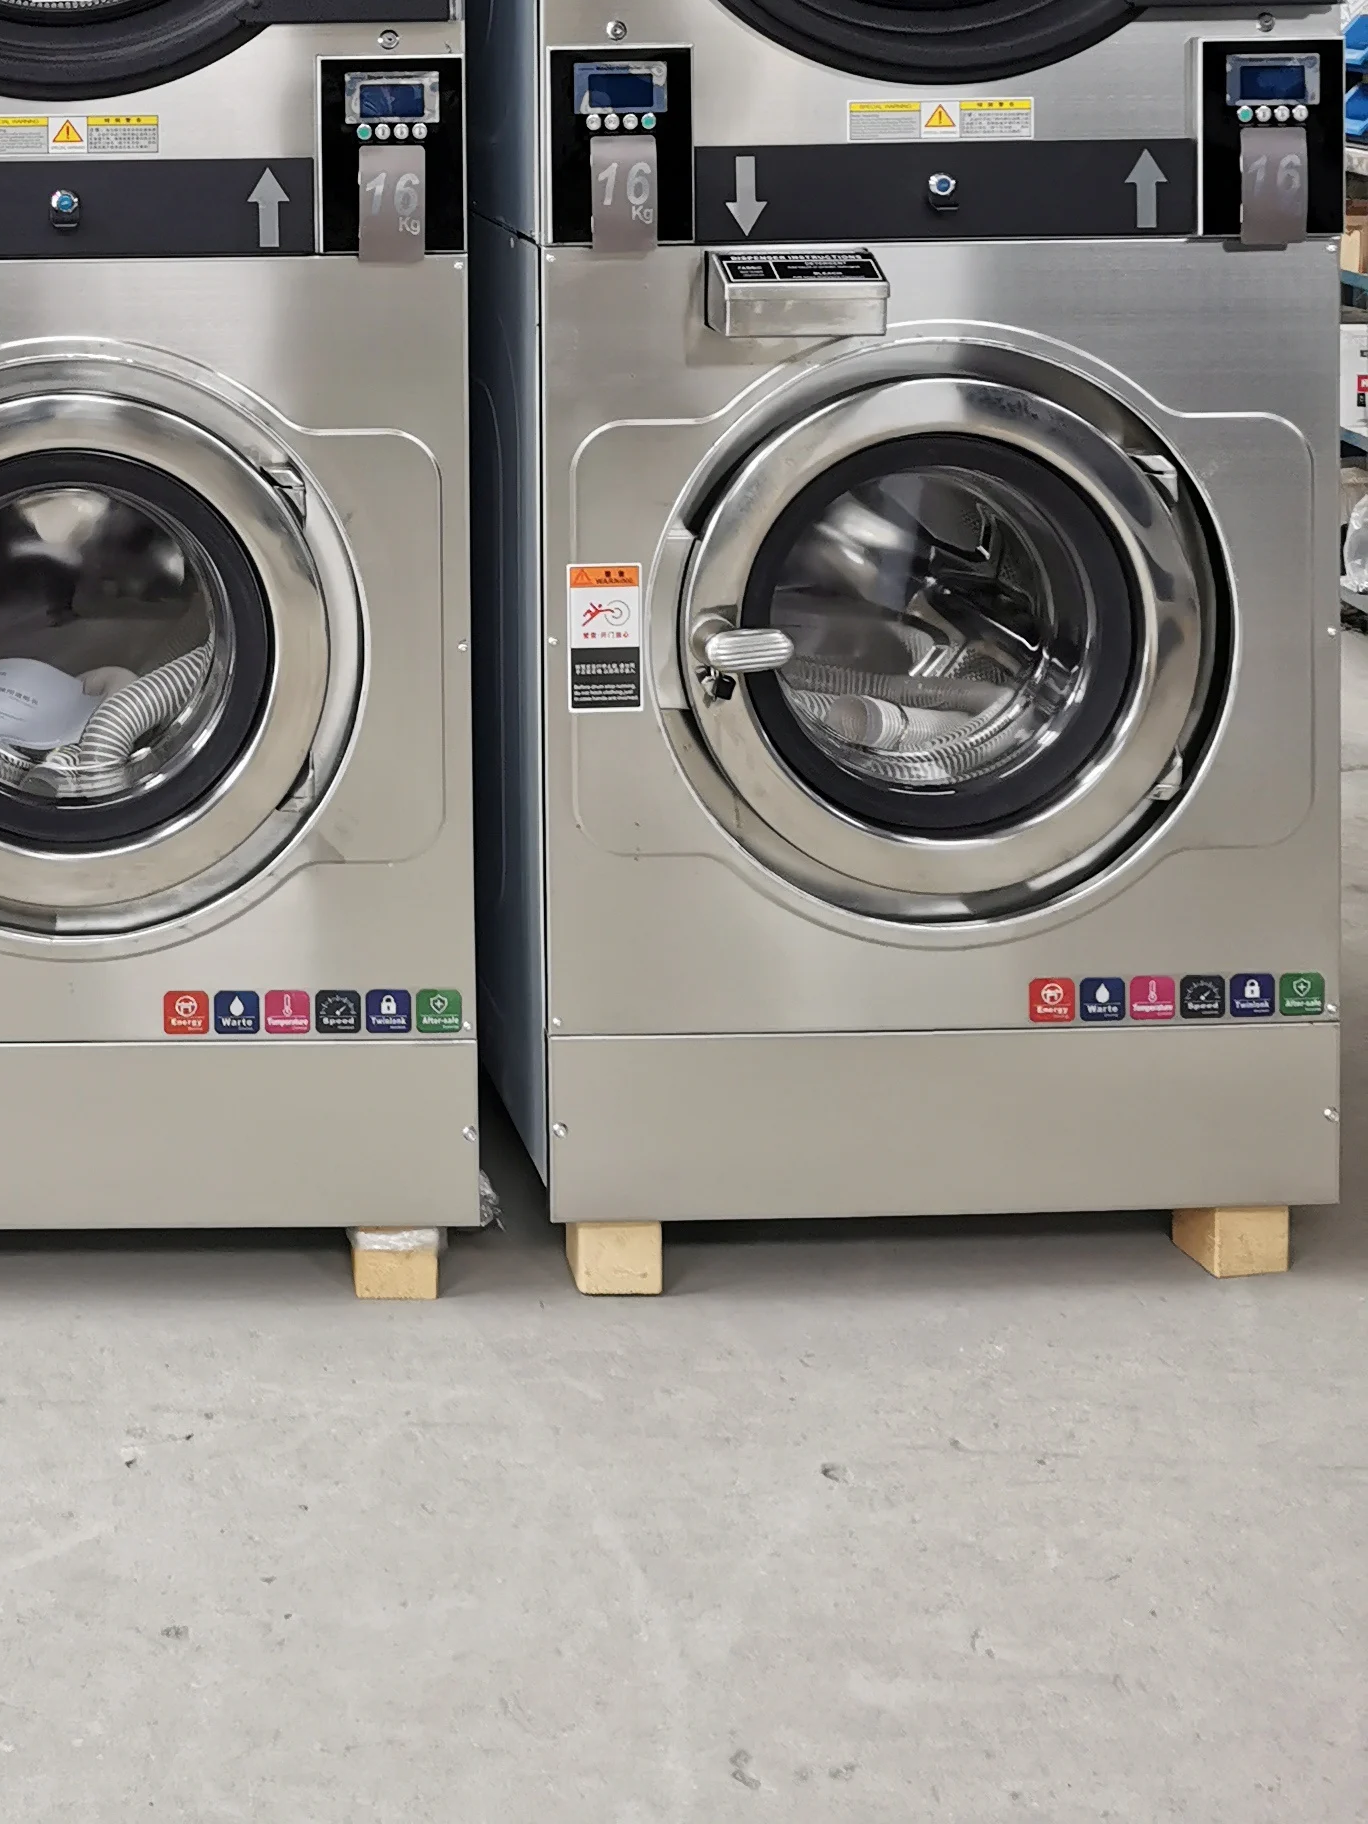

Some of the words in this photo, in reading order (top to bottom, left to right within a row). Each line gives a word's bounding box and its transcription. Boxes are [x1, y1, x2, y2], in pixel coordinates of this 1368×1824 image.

[598, 162, 651, 206] 16
[1247, 154, 1302, 195] 16
[366, 172, 420, 217] 16
[632, 205, 654, 225] Kg
[398, 216, 421, 235] Kg
[1036, 1006, 1068, 1014] Energy
[1187, 1002, 1218, 1010] Speed
[171, 1018, 202, 1027] Energy
[322, 1017, 354, 1025] Speed
